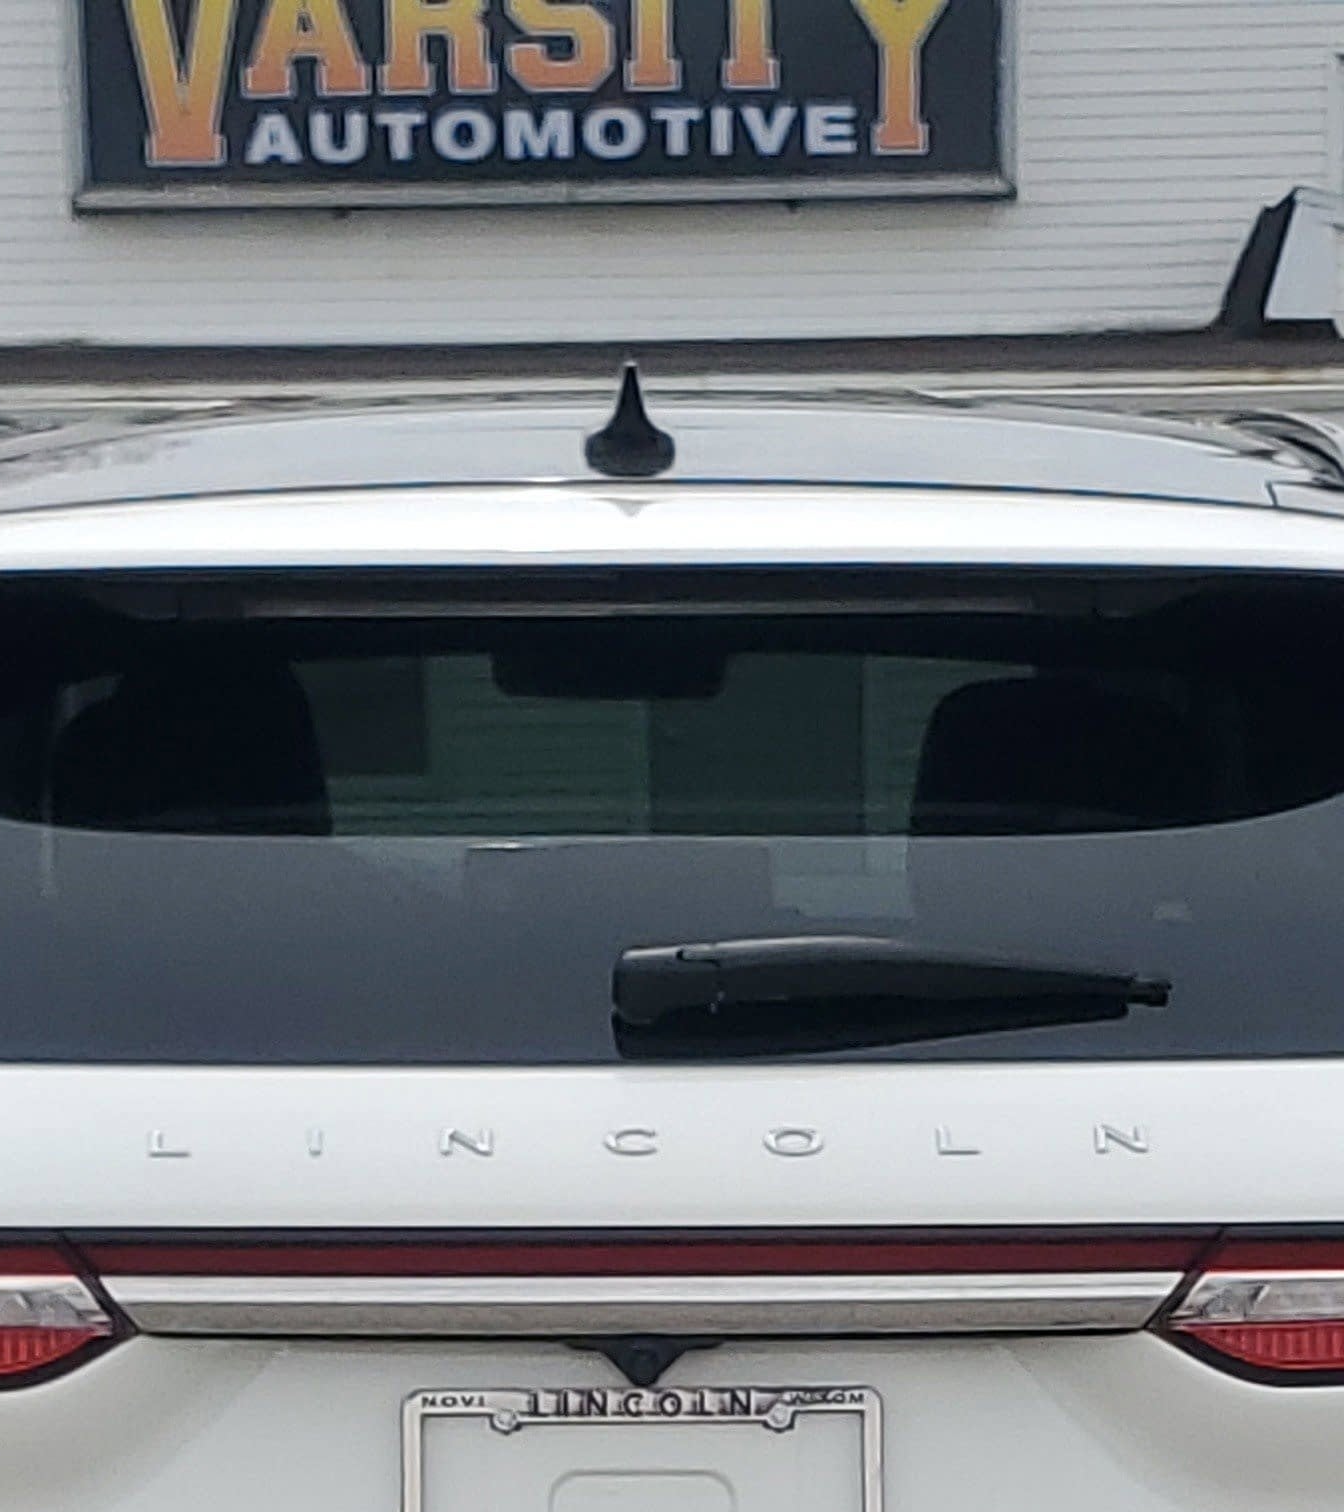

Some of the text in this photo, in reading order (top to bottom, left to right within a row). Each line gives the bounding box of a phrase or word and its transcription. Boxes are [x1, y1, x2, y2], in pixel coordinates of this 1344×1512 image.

[123, 0, 950, 167] VARSITY
[245, 104, 857, 165] AUTOMOTIVE
[147, 1124, 1149, 1158] LINCOLN
[421, 1395, 486, 1408] NOVI
[528, 1388, 753, 1417] LINCOLN
